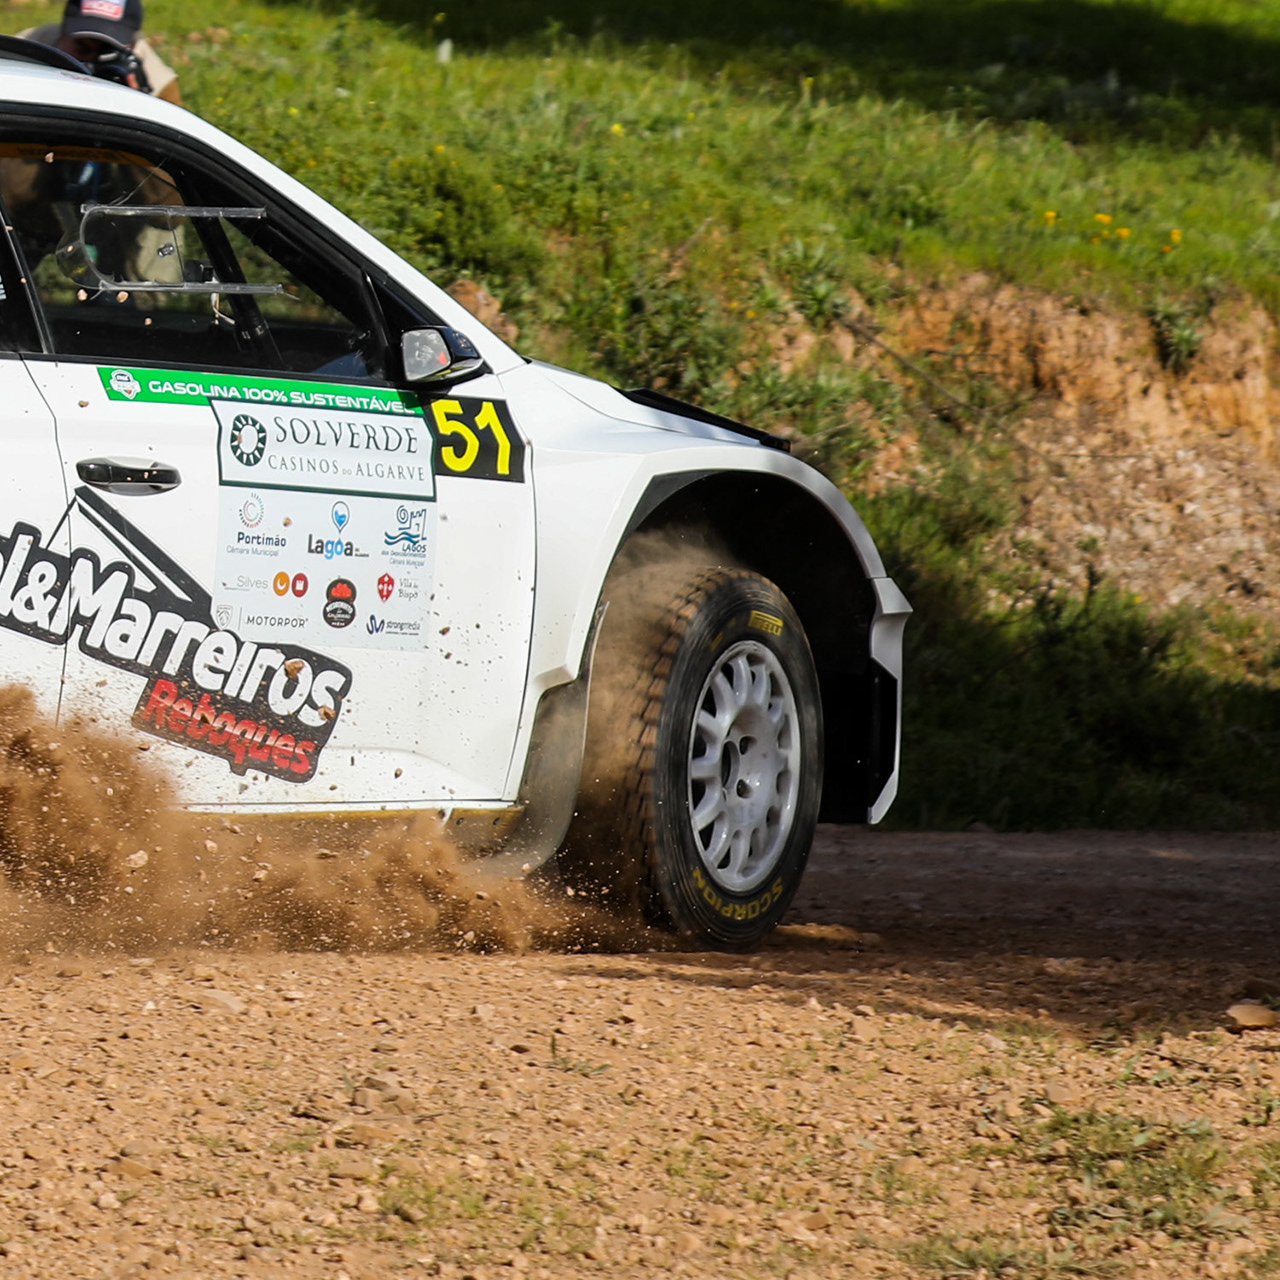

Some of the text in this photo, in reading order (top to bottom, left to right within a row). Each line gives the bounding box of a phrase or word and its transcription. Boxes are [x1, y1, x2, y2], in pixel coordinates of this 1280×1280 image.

[148, 380, 241, 399] GASOLINA
[242, 387, 288, 402] 100%
[290, 391, 415, 414] SUSTENTÁVEL
[274, 416, 417, 453] SOLVERDE
[431, 399, 511, 475] 51
[268, 455, 339, 474] CASINOS
[355, 462, 425, 481] ALGARVE
[237, 531, 287, 547] Portimão
[307, 533, 354, 560] Lagoa
[402, 543, 427, 553] LAGOS
[236, 575, 269, 589] Silves
[400, 578, 412, 588] Vila
[246, 616, 306, 628] MOTORPOR
[141, 679, 317, 775] Reboques
[692, 868, 784, 920] SCORPION
